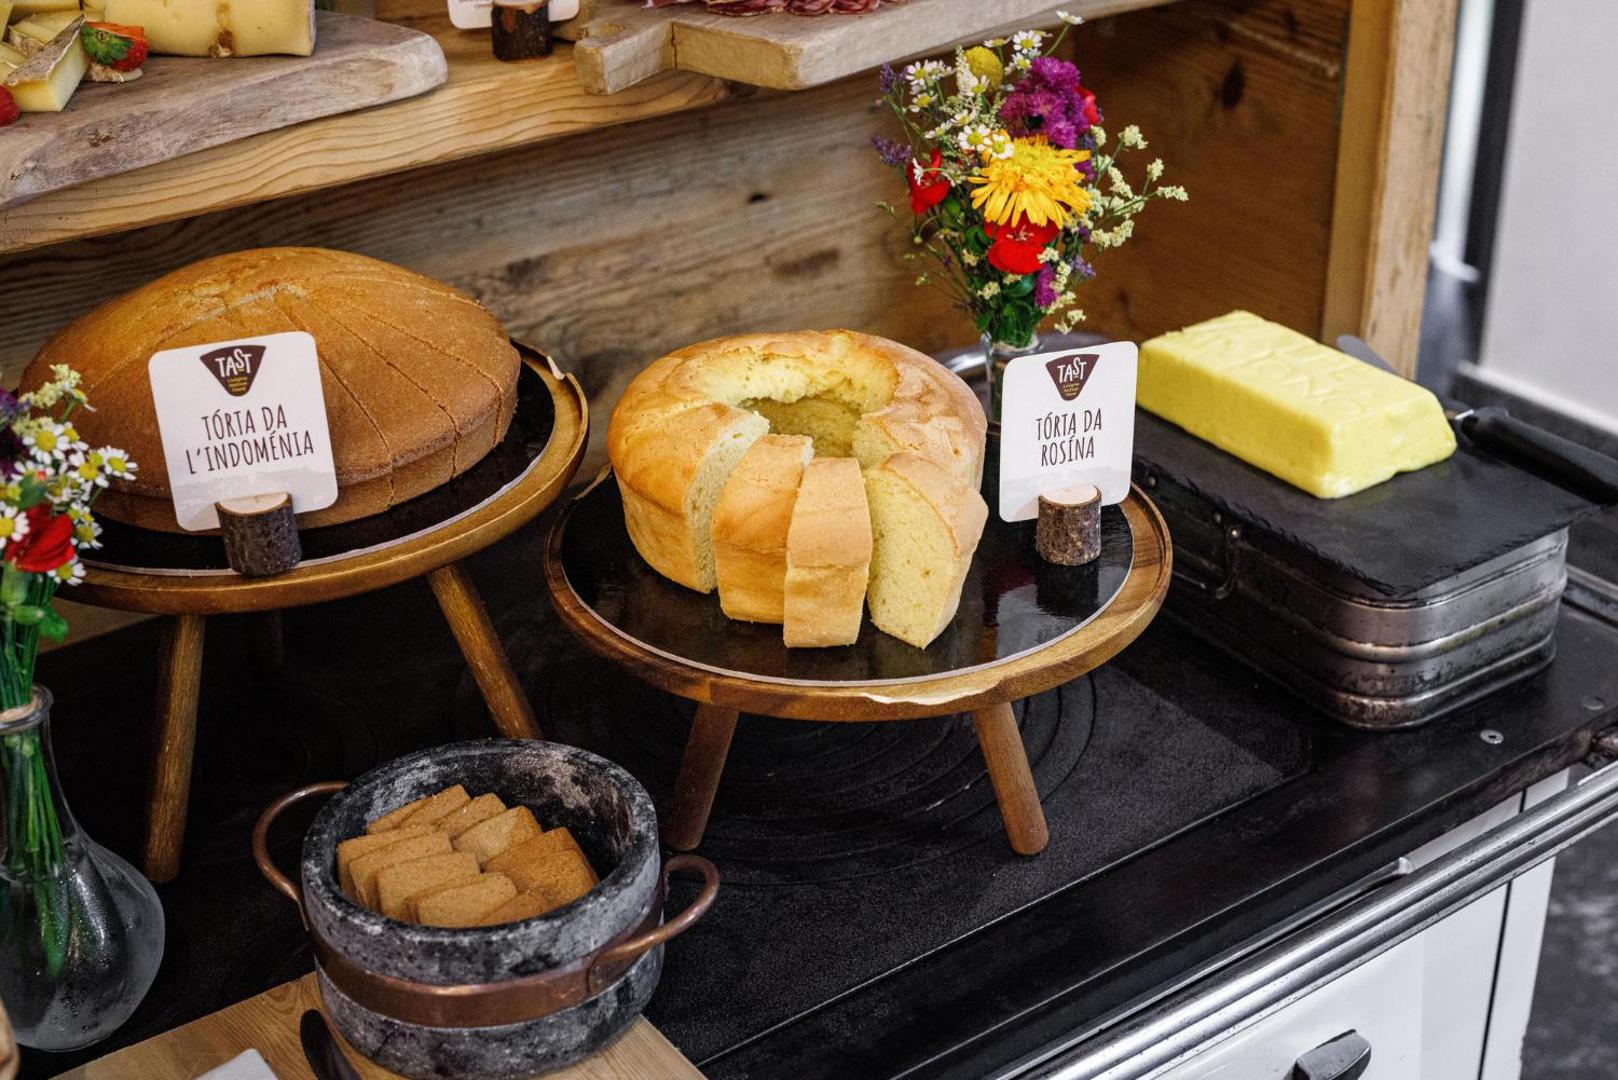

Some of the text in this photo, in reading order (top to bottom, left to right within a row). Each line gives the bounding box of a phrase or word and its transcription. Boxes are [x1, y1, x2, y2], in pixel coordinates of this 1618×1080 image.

[214, 348, 252, 378] TAST
[1056, 357, 1087, 383] TAST
[201, 404, 288, 441] TÓRTA DA
[1036, 408, 1103, 441] TÓRTA DA
[1041, 435, 1095, 467] ROSÍNA
